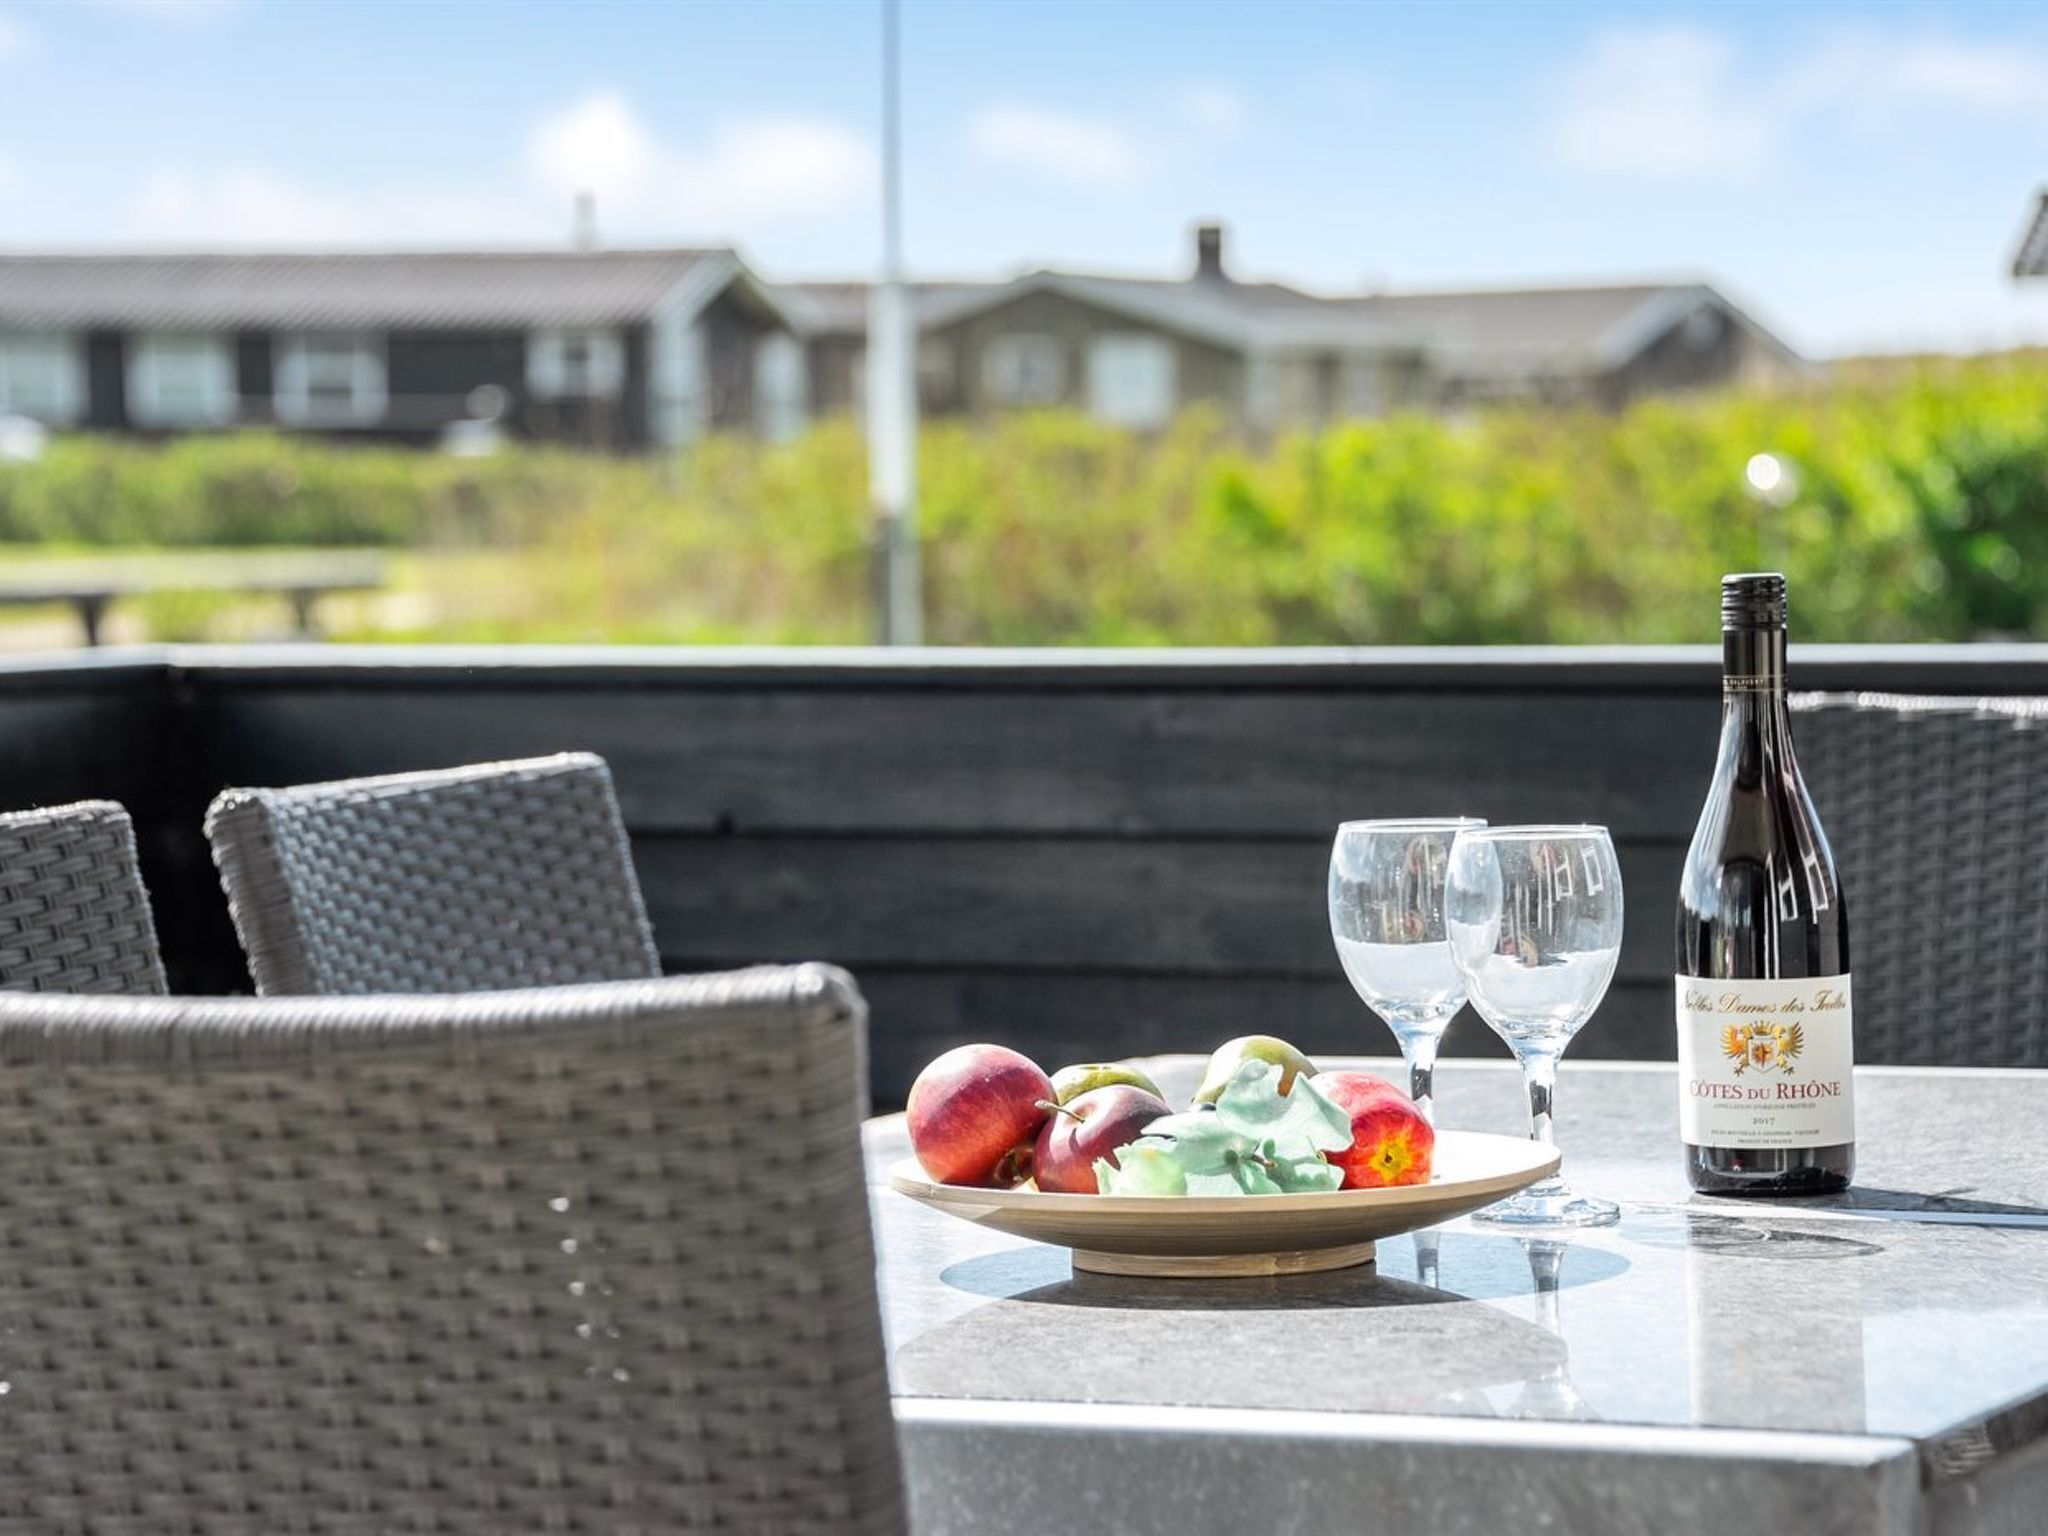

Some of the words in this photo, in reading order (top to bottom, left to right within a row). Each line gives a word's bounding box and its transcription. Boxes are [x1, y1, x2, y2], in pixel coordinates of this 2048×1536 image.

[1716, 991, 1777, 1014] Dames
[1780, 998, 1805, 1013] des
[1690, 1080, 1742, 1100] CÔTES
[1748, 1088, 1770, 1100] DU
[1776, 1080, 1841, 1100] RHÔNE
[1752, 1117, 1775, 1125] 2017
